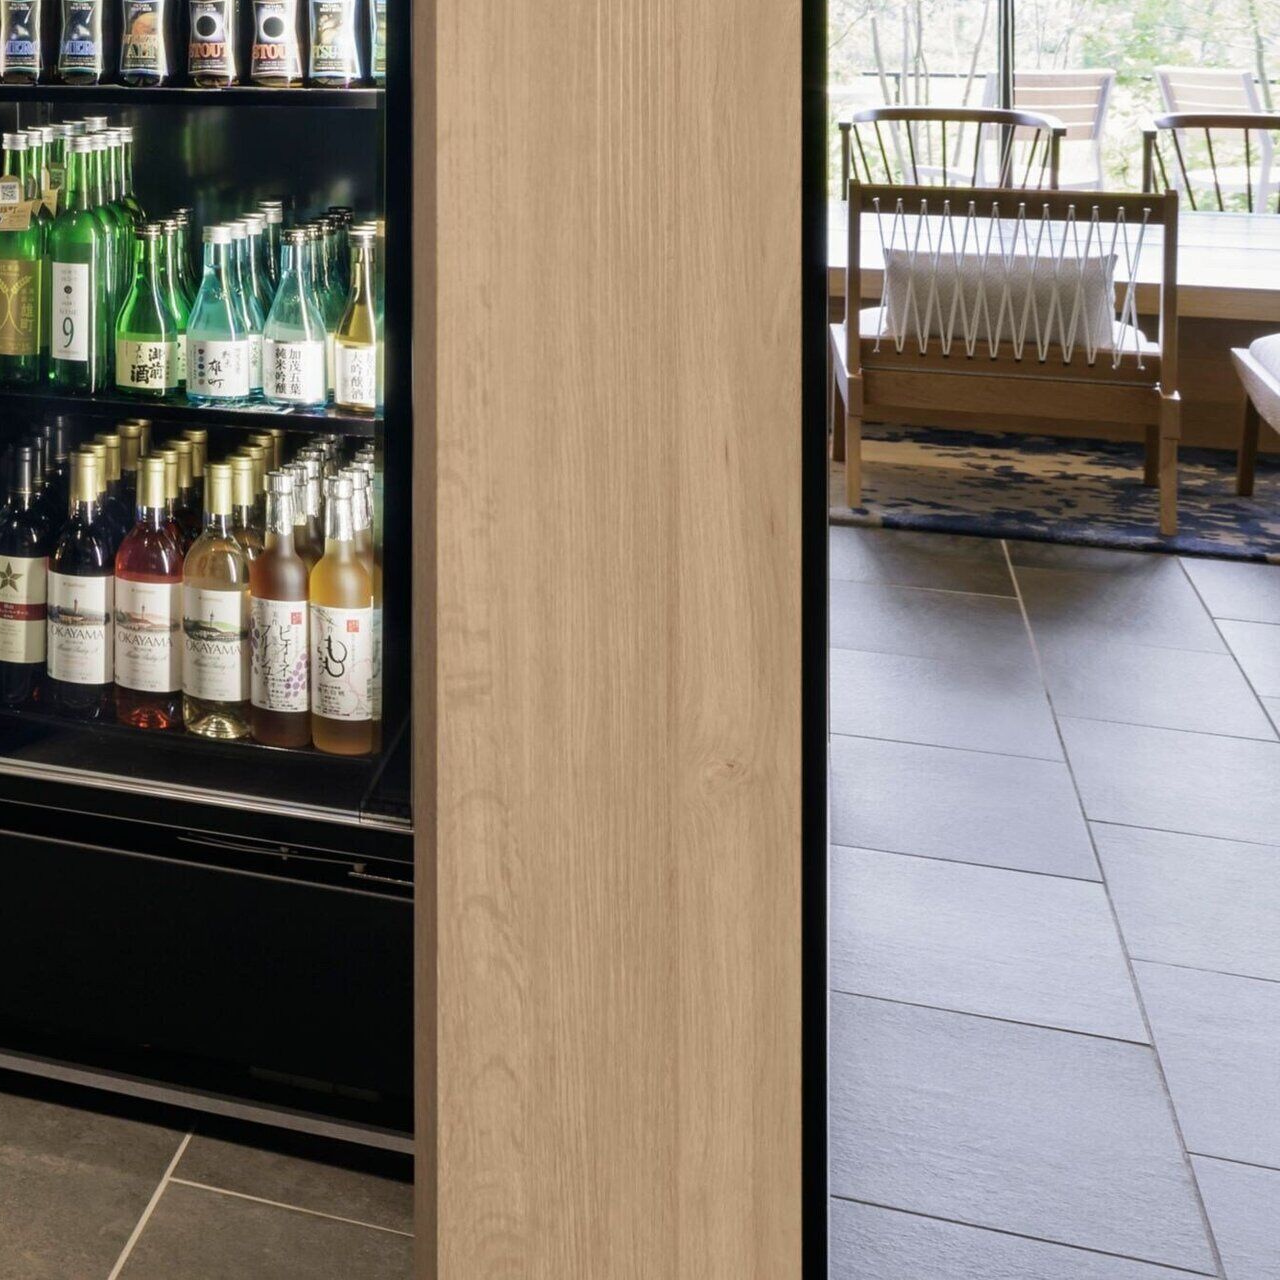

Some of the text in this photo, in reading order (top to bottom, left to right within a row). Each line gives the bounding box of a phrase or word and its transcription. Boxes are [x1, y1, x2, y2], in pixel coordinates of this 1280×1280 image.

[62, 317, 74, 348] 9
[130, 364, 149, 384] 酒
[275, 348, 287, 394] 純米吟醸
[50, 625, 103, 641] OKAYAMA
[118, 631, 172, 648] OKAYAMA
